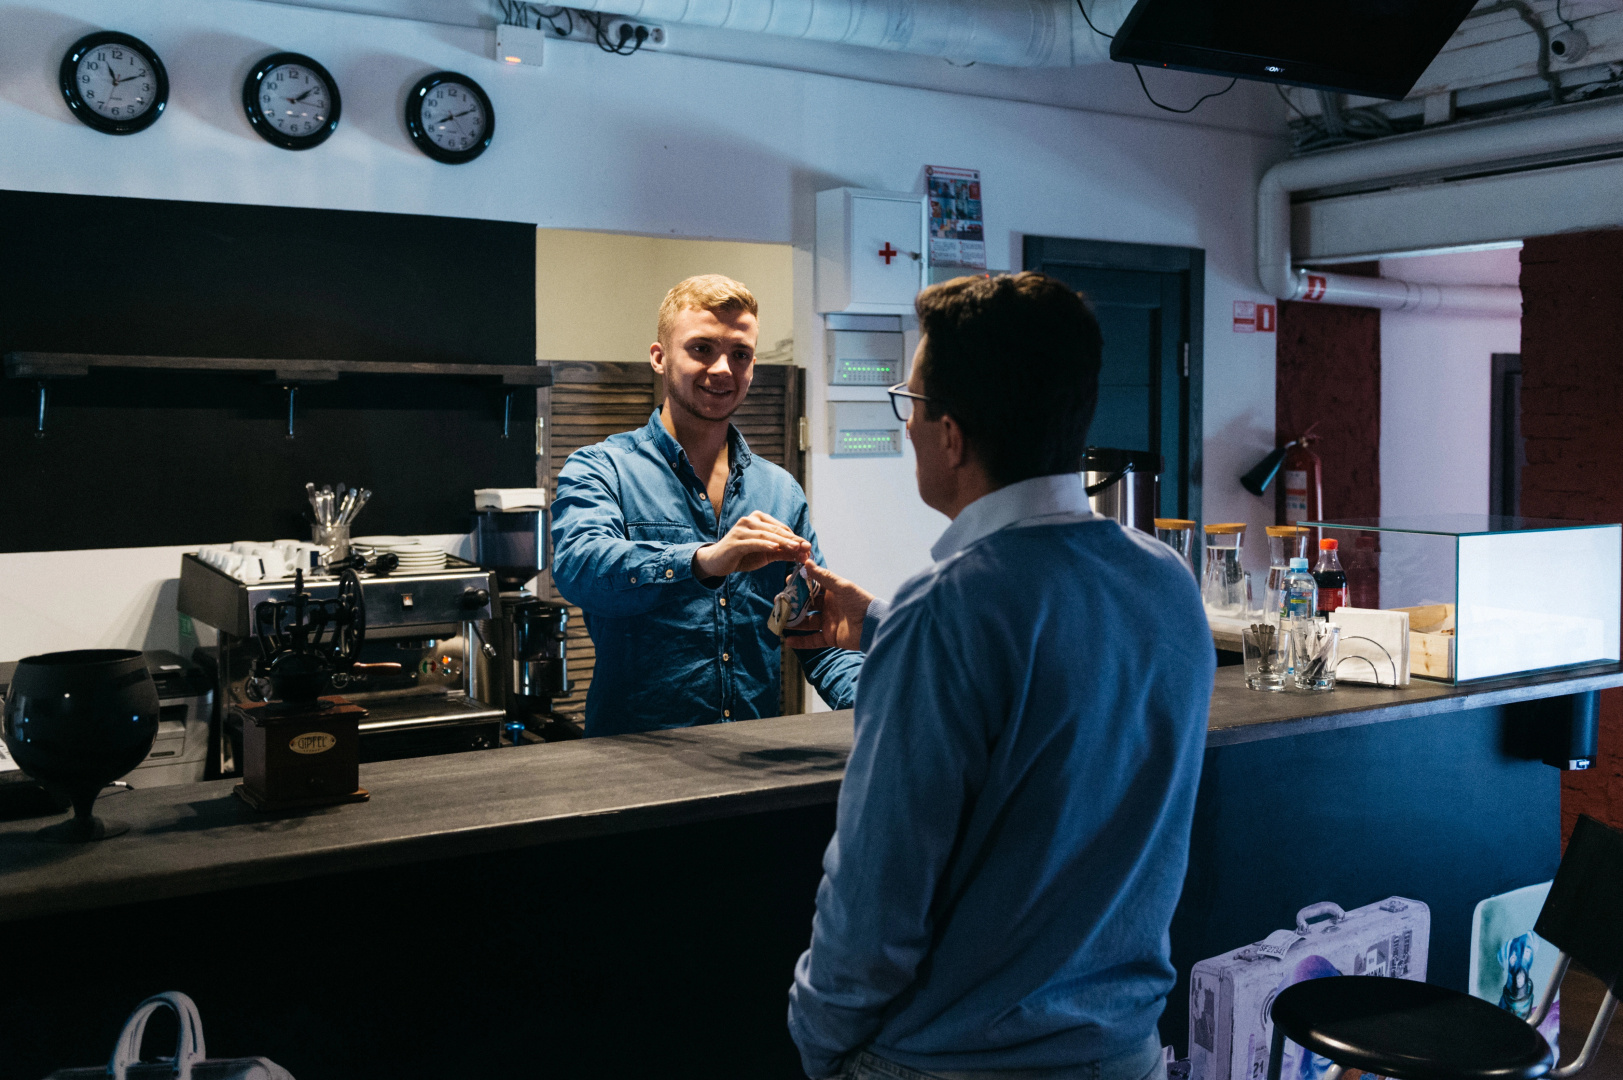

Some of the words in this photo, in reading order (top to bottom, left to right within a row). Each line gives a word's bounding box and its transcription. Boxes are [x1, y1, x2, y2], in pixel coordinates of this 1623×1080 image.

[97, 52, 106, 62] 11
[112, 50, 123, 60] 12
[129, 56, 134, 66] 1
[86, 61, 99, 71] 10
[139, 68, 146, 77] 2
[276, 72, 284, 82] 11
[288, 70, 299, 79] 12
[81, 74, 90, 84] 9
[305, 75, 309, 84] 1
[142, 83, 150, 92] 3
[266, 81, 278, 91] 10
[312, 86, 320, 95] 2
[86, 89, 95, 99] 8
[436, 90, 444, 99] 11
[448, 88, 458, 97] 12
[262, 94, 271, 103] 9
[462, 93, 467, 102] 1
[97, 100, 105, 110] 7
[428, 98, 438, 107] 10
[111, 106, 120, 116] 6
[126, 105, 135, 114] 5
[424, 110, 432, 119] 9
[277, 118, 284, 127] 7
[304, 121, 312, 130] 5
[472, 117, 480, 125] 3
[290, 123, 298, 132] 6
[428, 124, 435, 133] 8
[469, 129, 476, 138] 4
[448, 139, 456, 147] 6
[460, 137, 467, 146] 5
[1253, 1060, 1265, 1079] 21
